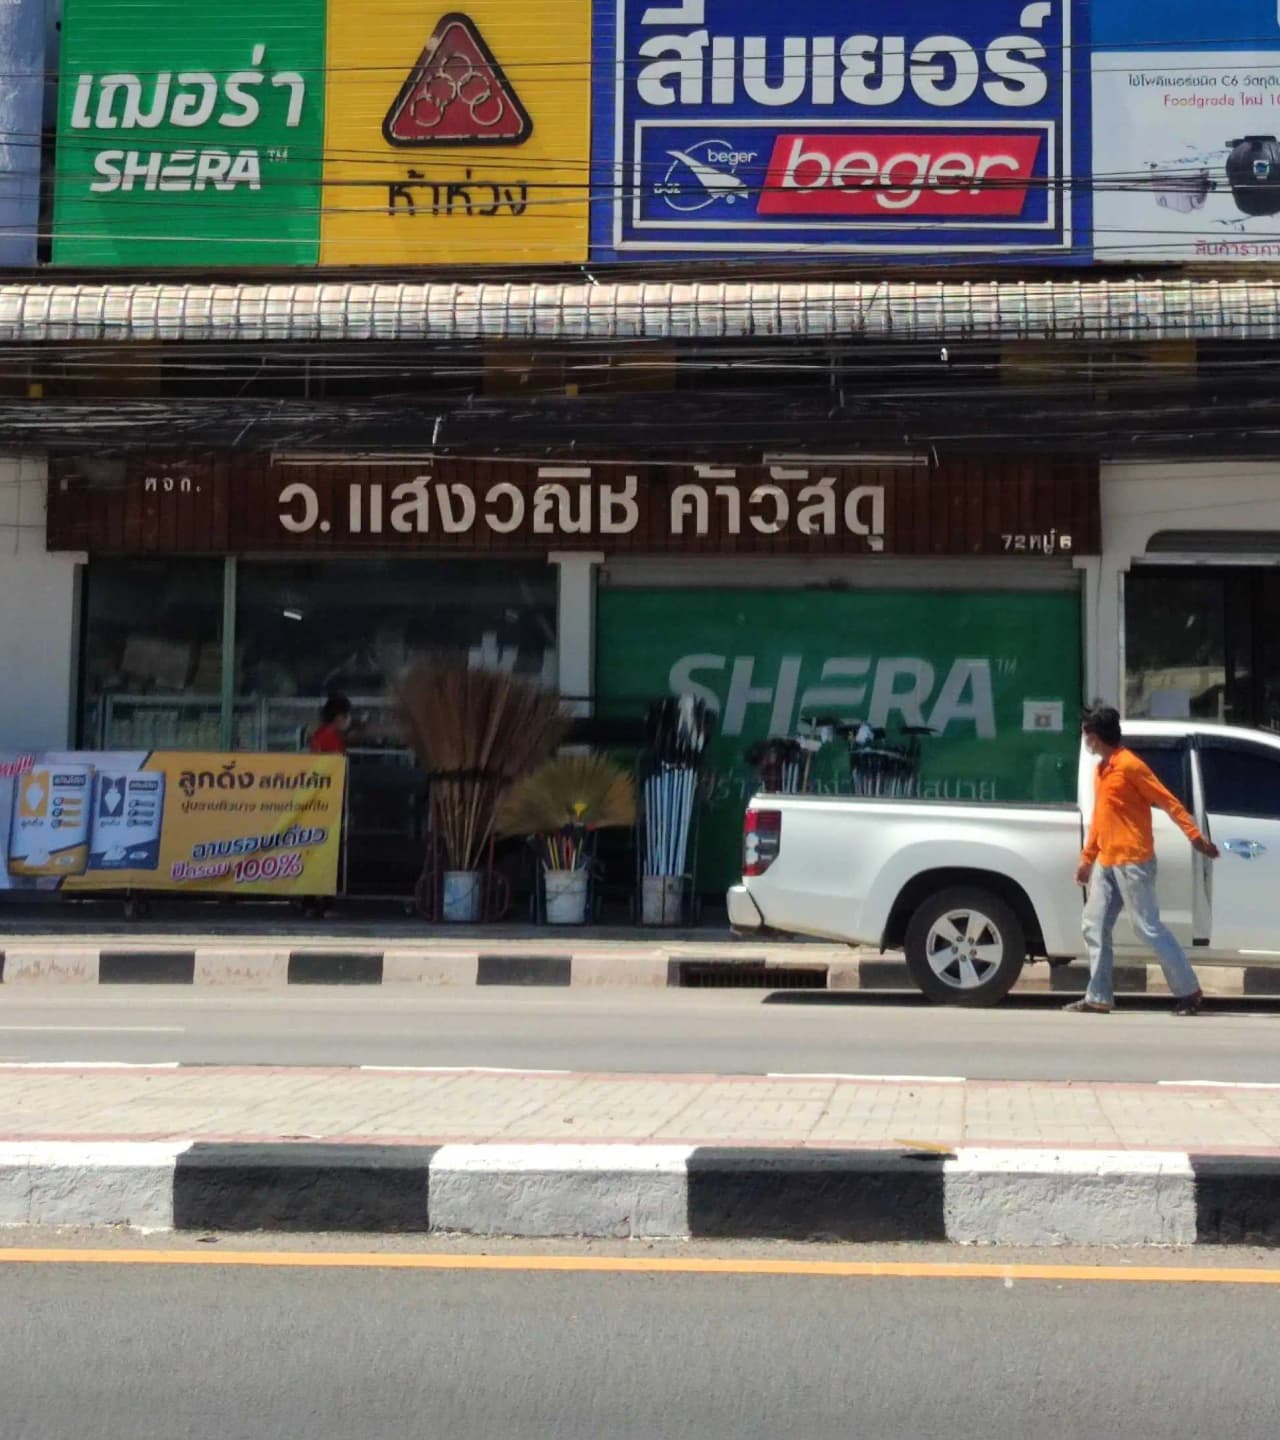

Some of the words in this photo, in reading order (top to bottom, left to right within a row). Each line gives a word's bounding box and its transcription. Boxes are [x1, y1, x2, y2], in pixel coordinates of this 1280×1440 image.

[71, 43, 305, 129] เฌอร่า
[1164, 93, 1235, 109] Foodgrade
[90, 148, 261, 192] SHERA
[707, 148, 758, 166] beger
[782, 137, 1019, 209] beger
[388, 169, 528, 217] ห้าห่วง
[671, 465, 885, 551] ค้าวัสดุ
[669, 653, 997, 738] SHERA
[235, 852, 304, 884] 100%
